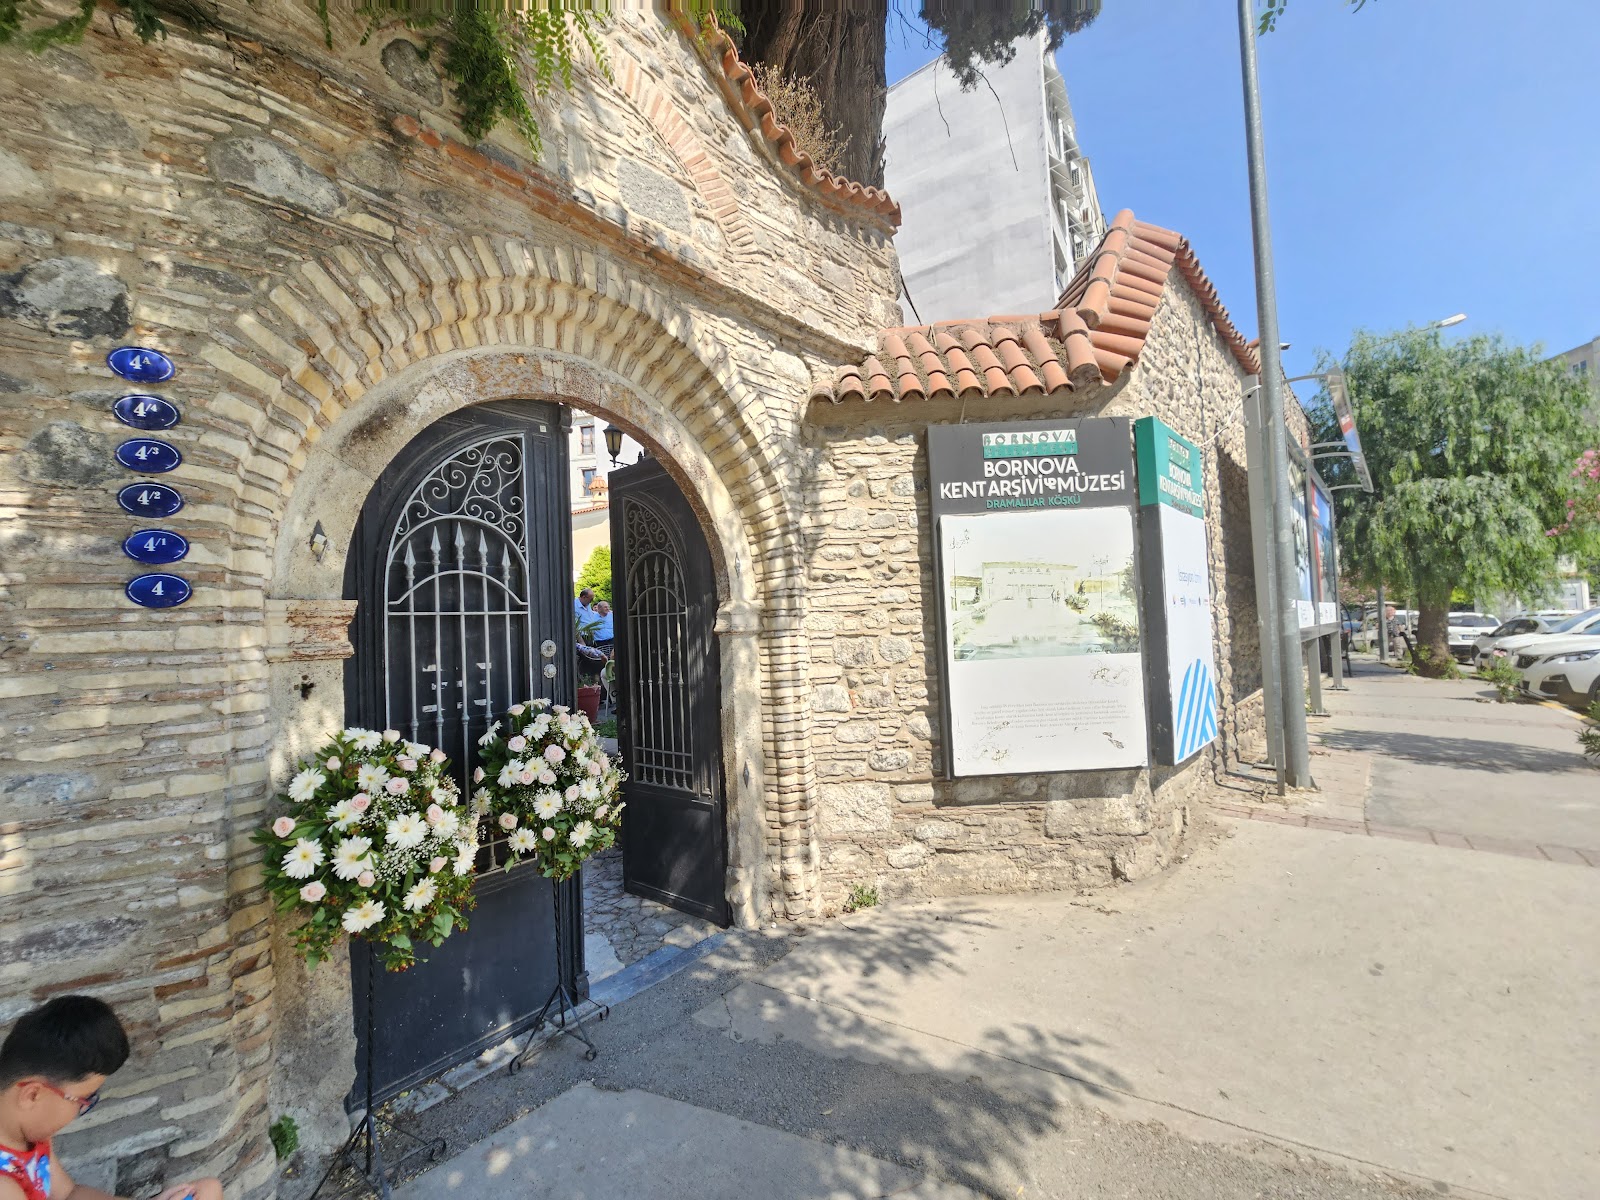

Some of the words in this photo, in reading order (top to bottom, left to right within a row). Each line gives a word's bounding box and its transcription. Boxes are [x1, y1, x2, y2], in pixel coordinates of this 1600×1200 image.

[129, 355, 151, 370] 4A
[133, 402, 158, 417] 4/4
[984, 431, 1075, 446] BORNOVA
[135, 445, 160, 461] 4/3
[984, 457, 1079, 478] BORNOVA
[940, 481, 987, 500] KENT
[988, 475, 1044, 498] ARŞİVİ
[1057, 470, 1126, 493] MÜZESİ
[137, 490, 161, 505] 4/2
[986, 498, 1045, 509] DRAMALILAR
[1048, 494, 1081, 506] KÖŞKÜ
[143, 537, 167, 552] 4/1
[151, 581, 164, 596] 4
